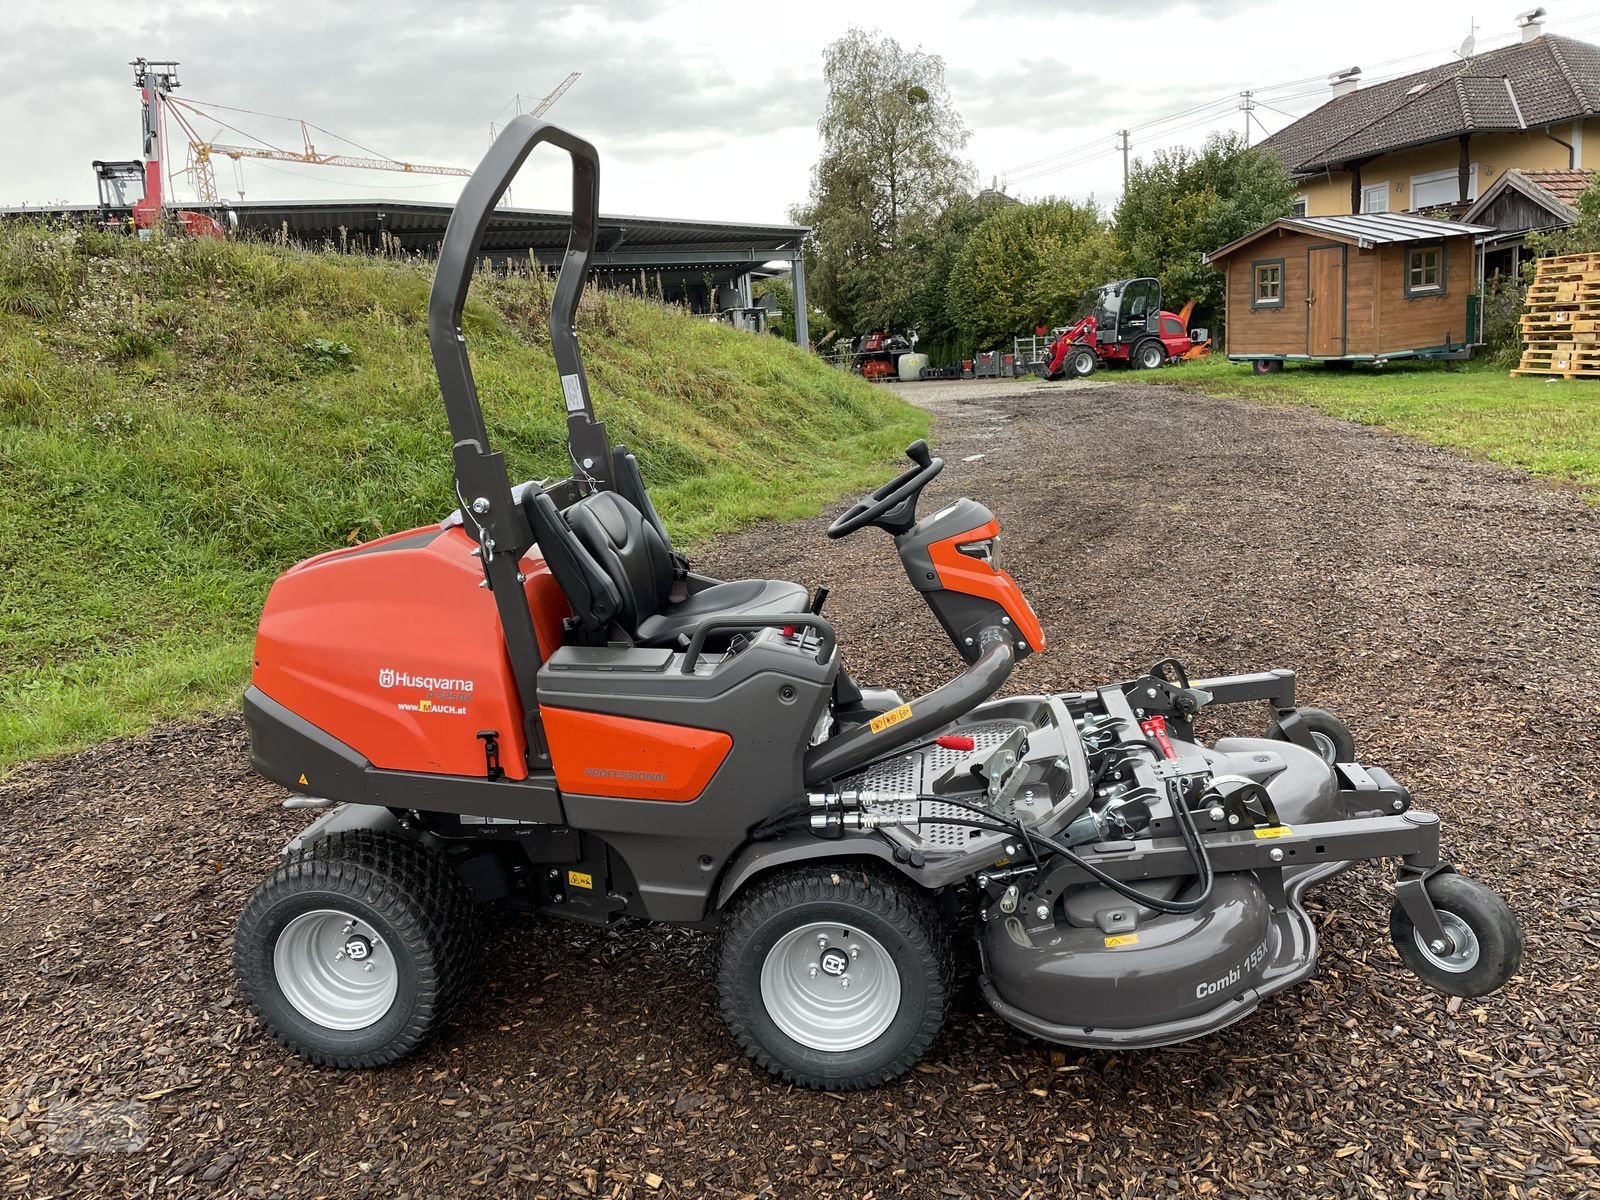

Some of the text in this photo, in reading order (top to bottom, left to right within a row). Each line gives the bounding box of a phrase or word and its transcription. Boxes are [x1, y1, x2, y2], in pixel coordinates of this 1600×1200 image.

[395, 672, 473, 691] Husqvarna
[427, 691, 435, 700] P
[584, 767, 668, 782] PROFESSIONAL
[1196, 938, 1268, 999] Combi 155X
